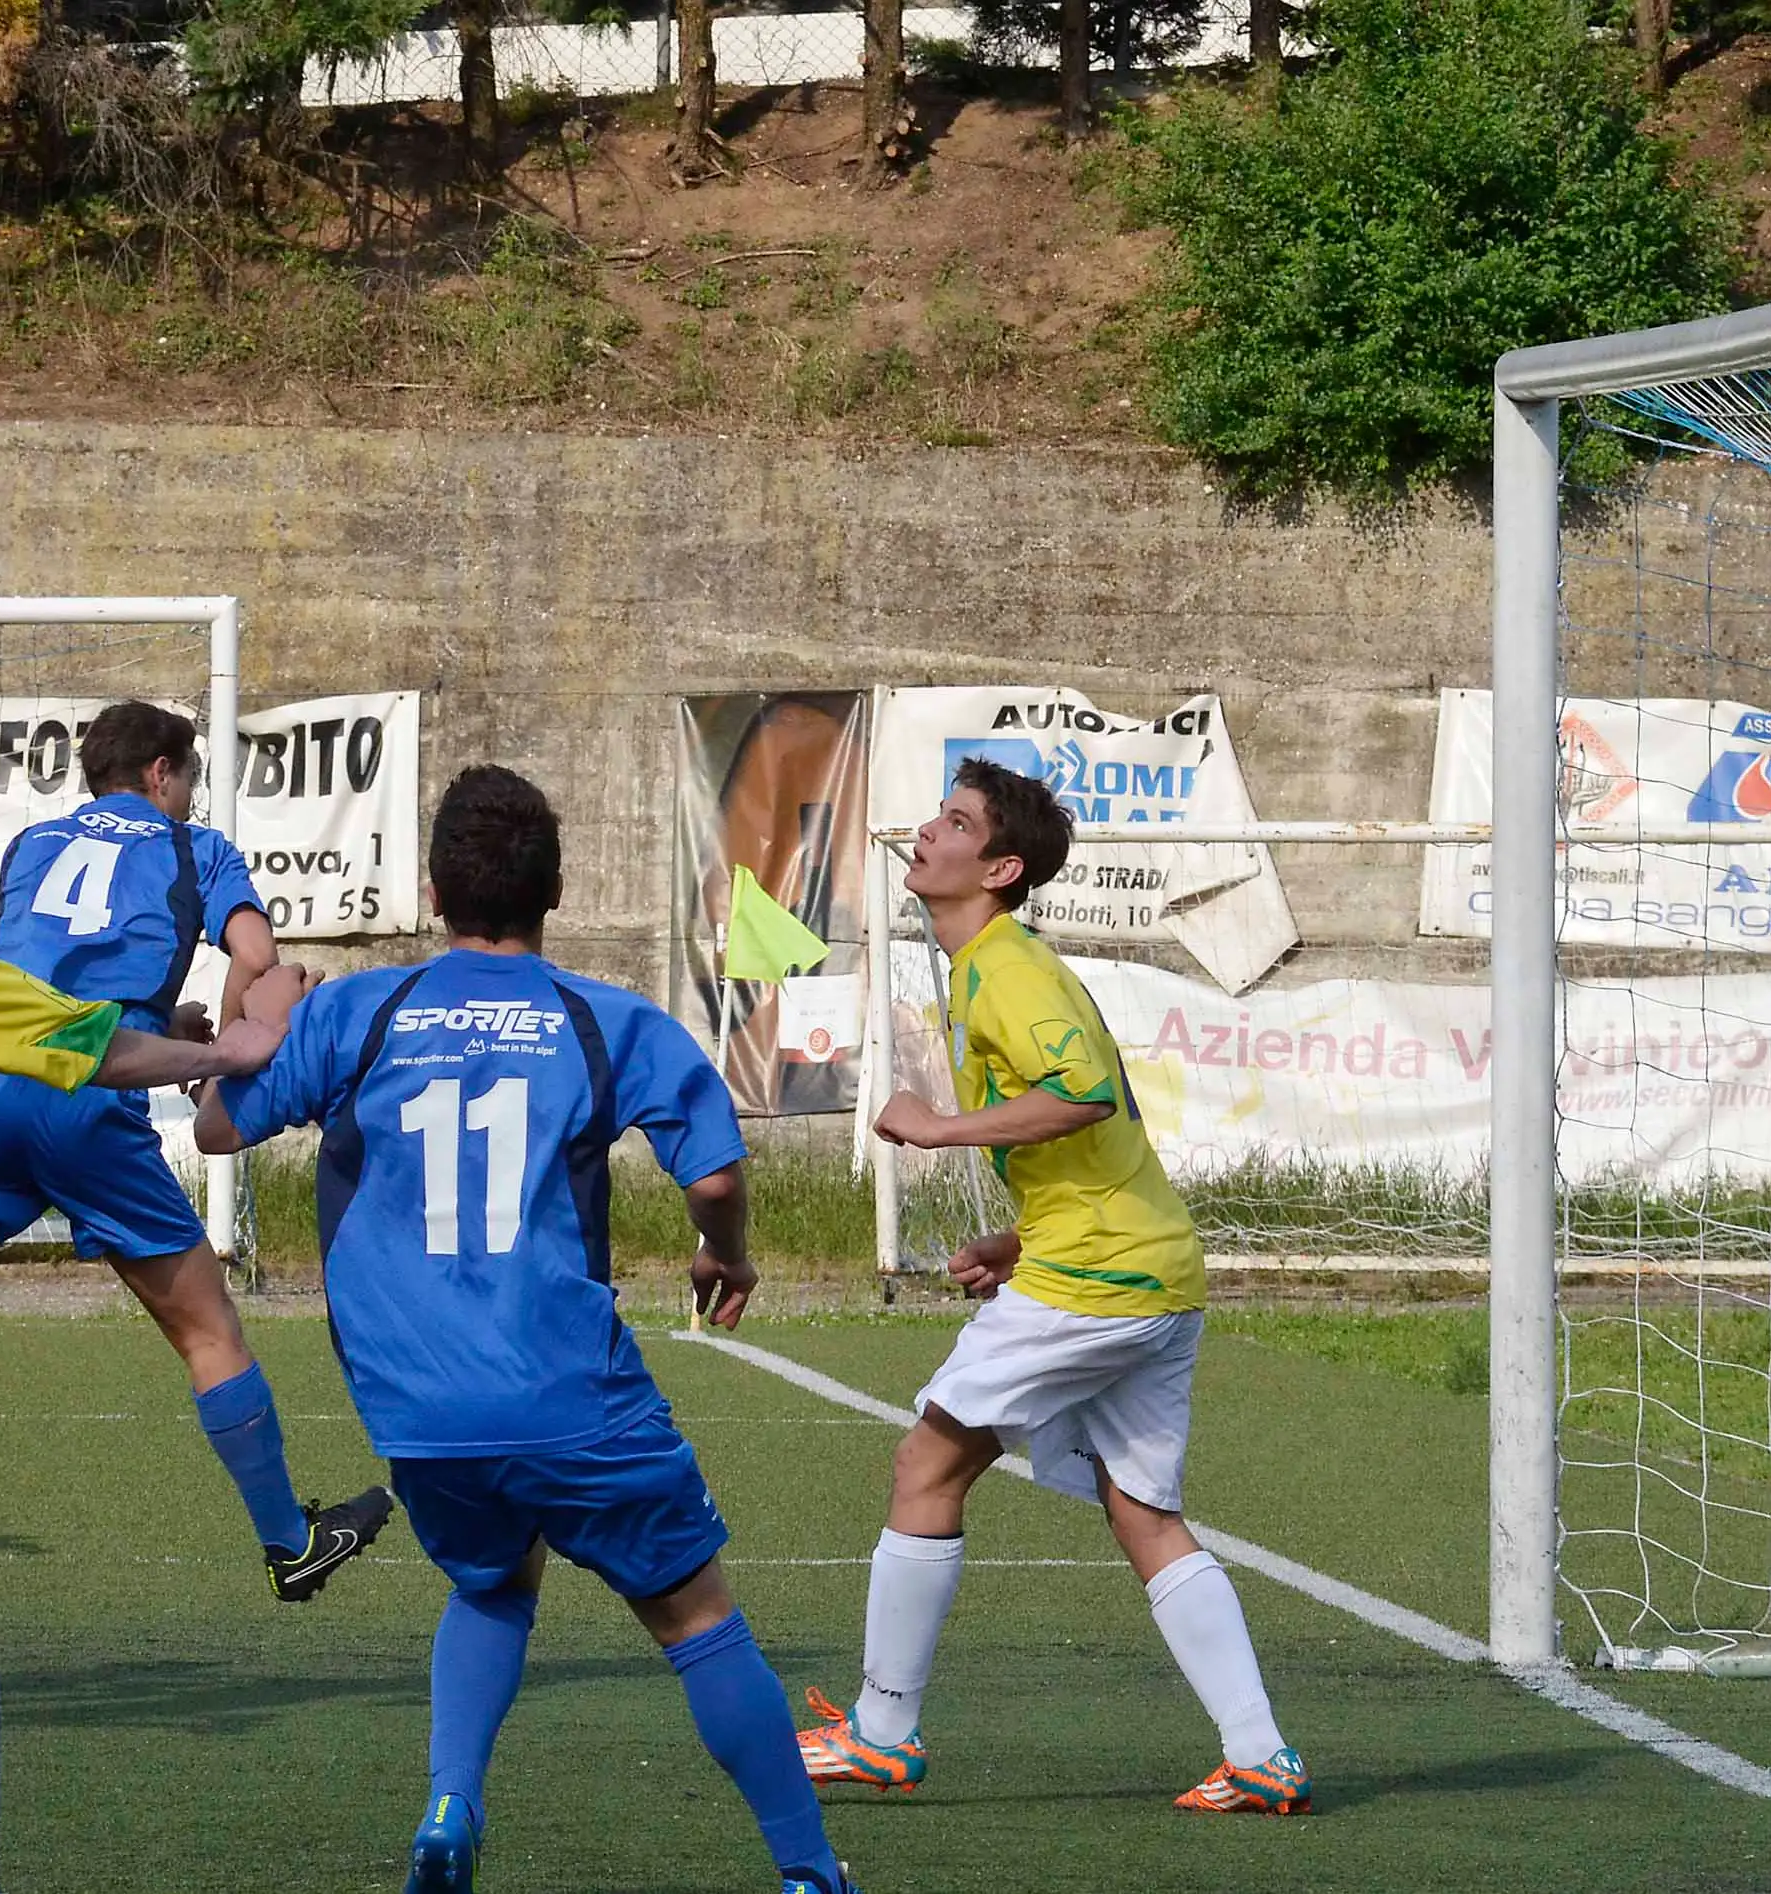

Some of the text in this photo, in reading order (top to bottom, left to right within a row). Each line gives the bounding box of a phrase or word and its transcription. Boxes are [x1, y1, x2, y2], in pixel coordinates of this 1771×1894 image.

[31, 837, 123, 936] 4
[393, 1000, 565, 1041] SPORTLER
[1146, 1006, 1429, 1081] Azienda
[400, 1077, 529, 1255] 11
